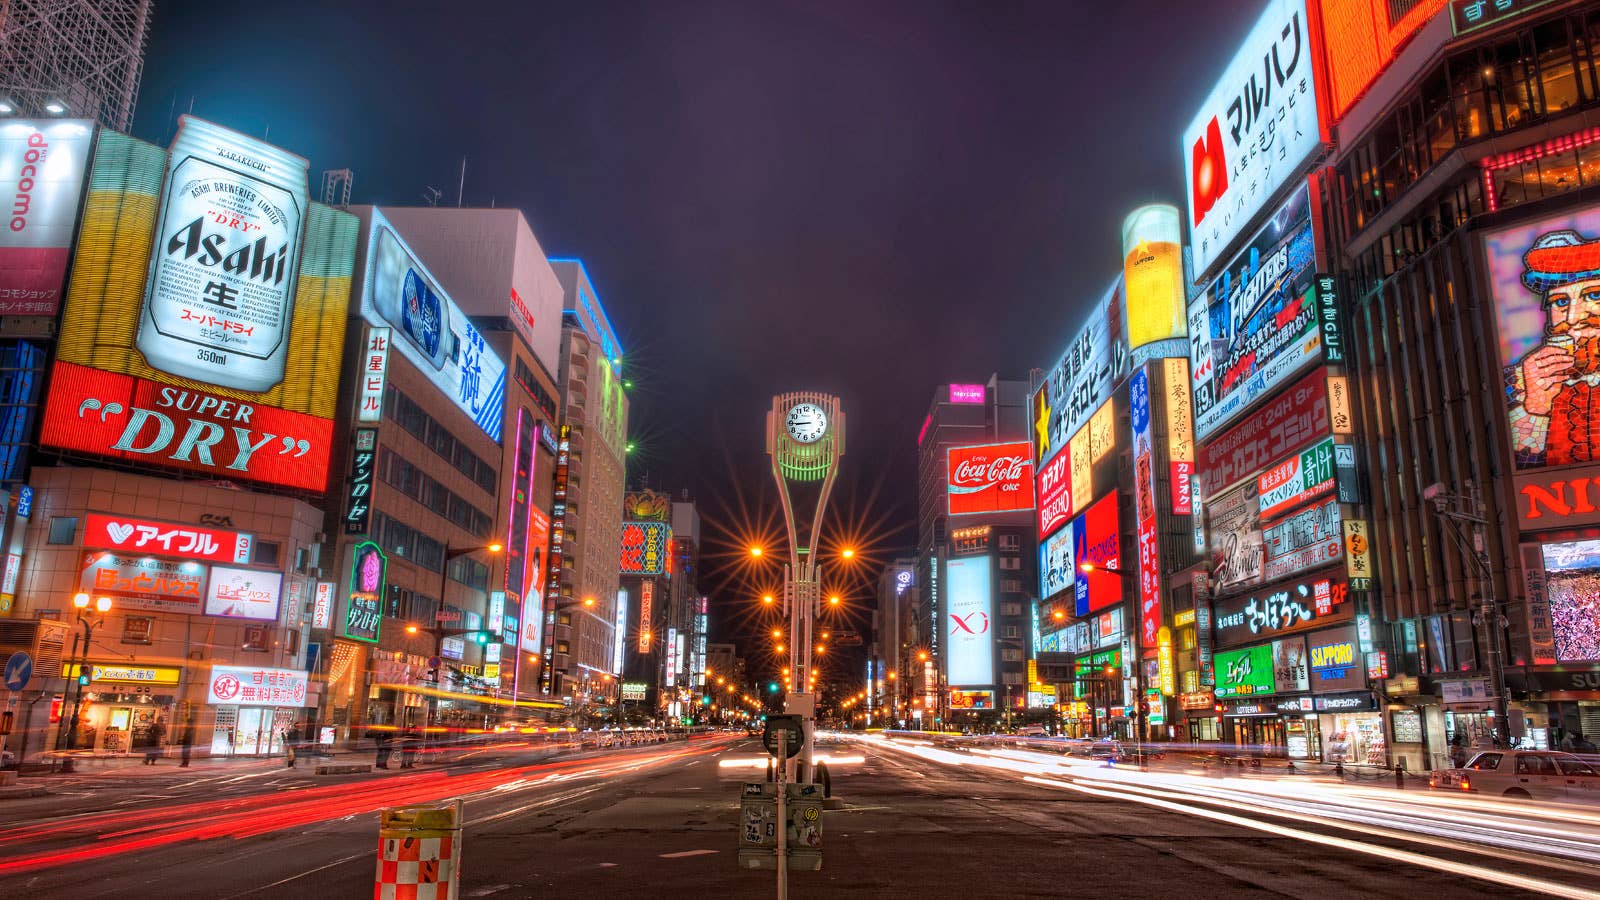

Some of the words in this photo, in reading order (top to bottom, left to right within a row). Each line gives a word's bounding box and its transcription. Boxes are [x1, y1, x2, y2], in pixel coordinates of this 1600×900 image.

[1226, 10, 1302, 147] マルハン
[1232, 78, 1308, 183] 人生にヨロコビを
[10, 133, 48, 232] docomo
[1201, 130, 1304, 254] 新しいパチンコへ
[191, 184, 211, 198] ASAHI
[214, 183, 257, 202] BREWERIES
[257, 199, 279, 225] LIMITED
[207, 210, 261, 233] "DRY"
[168, 215, 288, 286] Asahi
[0, 287, 58, 299] コモショップ
[203, 280, 239, 310] 生
[1228, 243, 1288, 352] FIGHTERS
[180, 309, 255, 337] スーパードライ
[199, 327, 232, 343] 生ビール
[1320, 277, 1342, 361] すすきのビル
[197, 348, 227, 366] 350ml
[1053, 326, 1094, 401] 北海道は
[1217, 318, 1278, 378] ファイターズを見ずに
[363, 336, 386, 411] 北星ビル
[458, 344, 483, 416] 純
[1055, 340, 1126, 443] サッポロビール
[156, 387, 254, 424] SUPER
[1265, 396, 1293, 426] 24H
[954, 455, 1024, 484] Coca-Cola
[1041, 455, 1066, 494] カラオケ
[1177, 462, 1190, 506] カラオケ
[1261, 461, 1295, 490] 新生活習慣
[1303, 446, 1333, 487] 青汁
[347, 453, 373, 521] サンローゼ
[1261, 480, 1303, 508] ヘスペリジン
[1520, 478, 1600, 519] NI
[1041, 503, 1053, 532] BIG
[1052, 490, 1070, 519] ECHO
[135, 525, 220, 556] アイフル
[1301, 546, 1327, 565] POPEYE
[95, 566, 201, 598] ほっとハウス
[217, 583, 272, 601] ほっとハウス
[1331, 583, 1348, 605] 2F
[1351, 578, 1370, 590] 4F
[1527, 570, 1548, 630] 北海道新聞
[315, 584, 328, 627] ほっとハウス
[1244, 584, 1312, 634] さっぽろっこ
[1225, 651, 1252, 684] エイブル
[1311, 643, 1353, 667] SAPPORO
[104, 669, 156, 681] CoCo壱番屋
[1236, 705, 1258, 714] LOTTERIA
